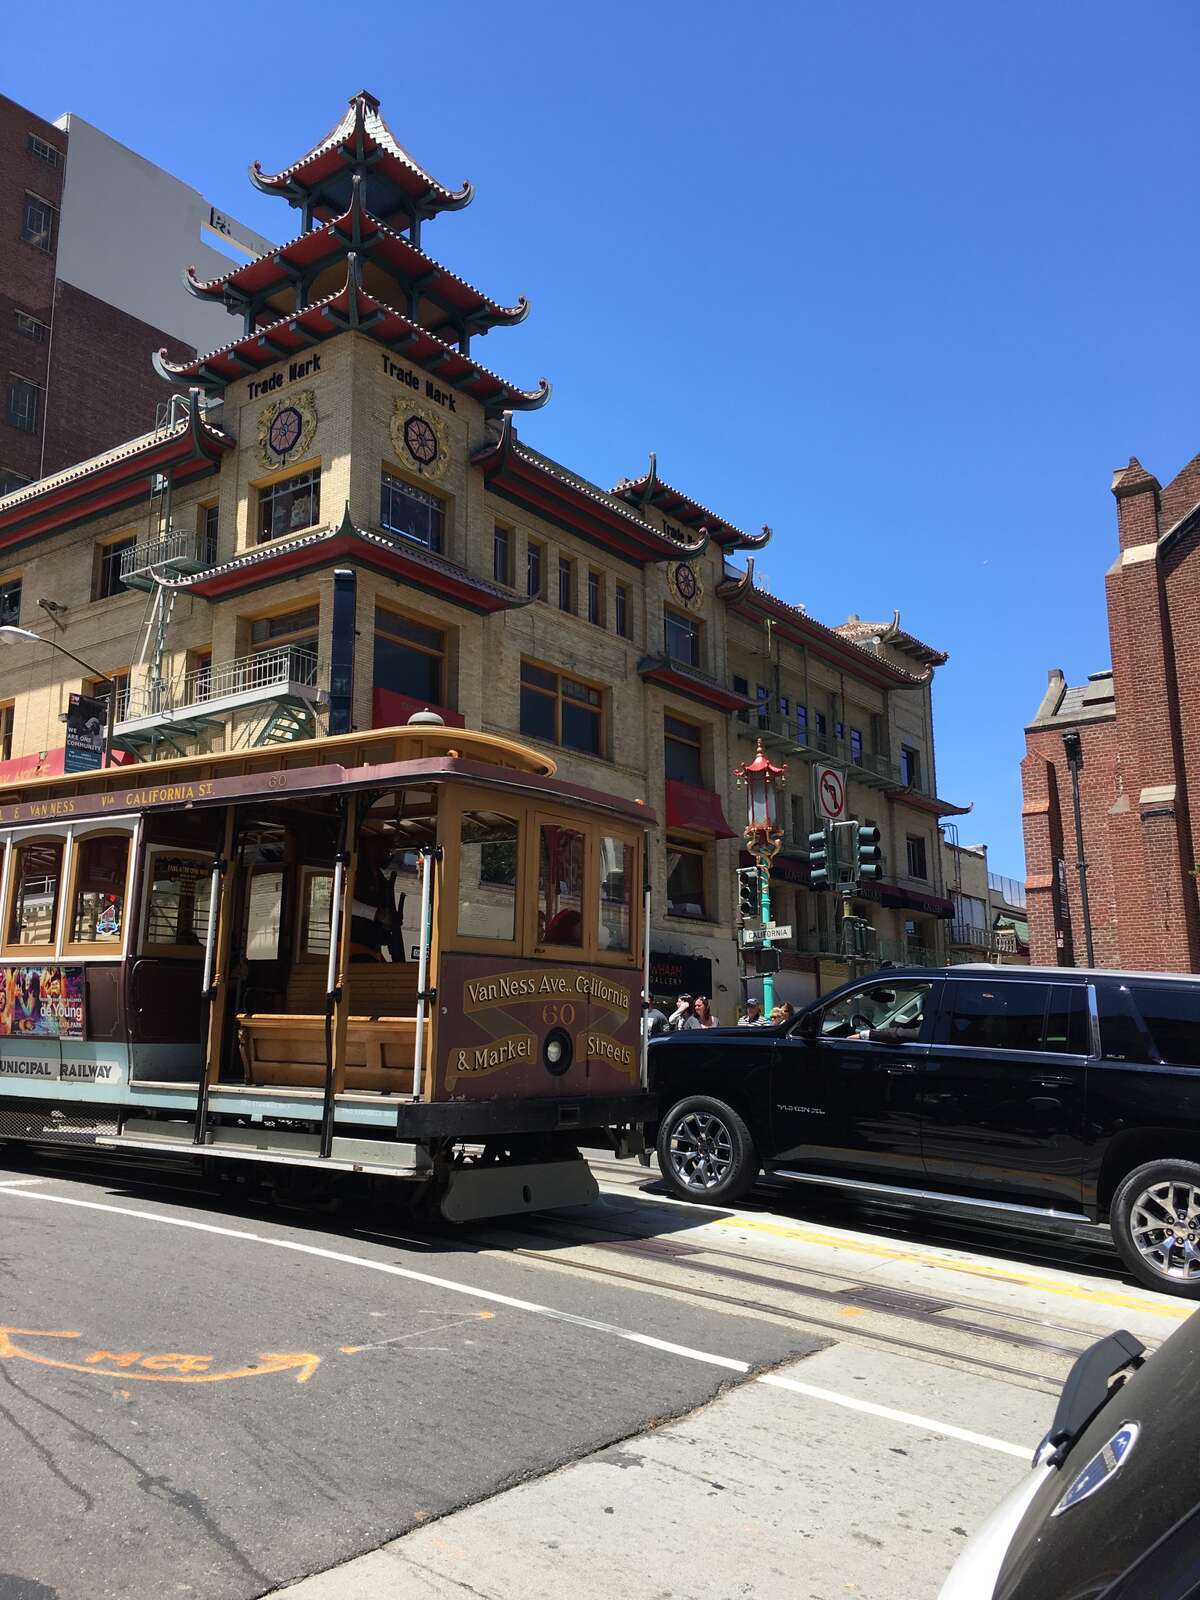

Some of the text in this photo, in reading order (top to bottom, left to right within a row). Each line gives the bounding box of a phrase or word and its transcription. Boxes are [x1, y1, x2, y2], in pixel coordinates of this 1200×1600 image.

[248, 353, 322, 400] Trade Mark
[382, 353, 457, 413] Trade Mark
[67, 740, 102, 752] COMMUNITY
[268, 774, 288, 788] 60
[30, 803, 49, 817] VAN
[49, 800, 74, 816] NESS
[126, 785, 195, 806] CALIFORNIA
[747, 929, 789, 940] CALIFORNIA
[467, 982, 498, 1004] Van
[499, 976, 537, 999] Ness
[575, 975, 631, 1009] California
[40, 1002, 83, 1022] de Young
[542, 1003, 576, 1025] 60
[456, 1037, 532, 1072] & Market
[586, 1035, 632, 1065] Streets
[60, 1063, 112, 1079] RAILWAY
[776, 1103, 811, 1113] YUKON
